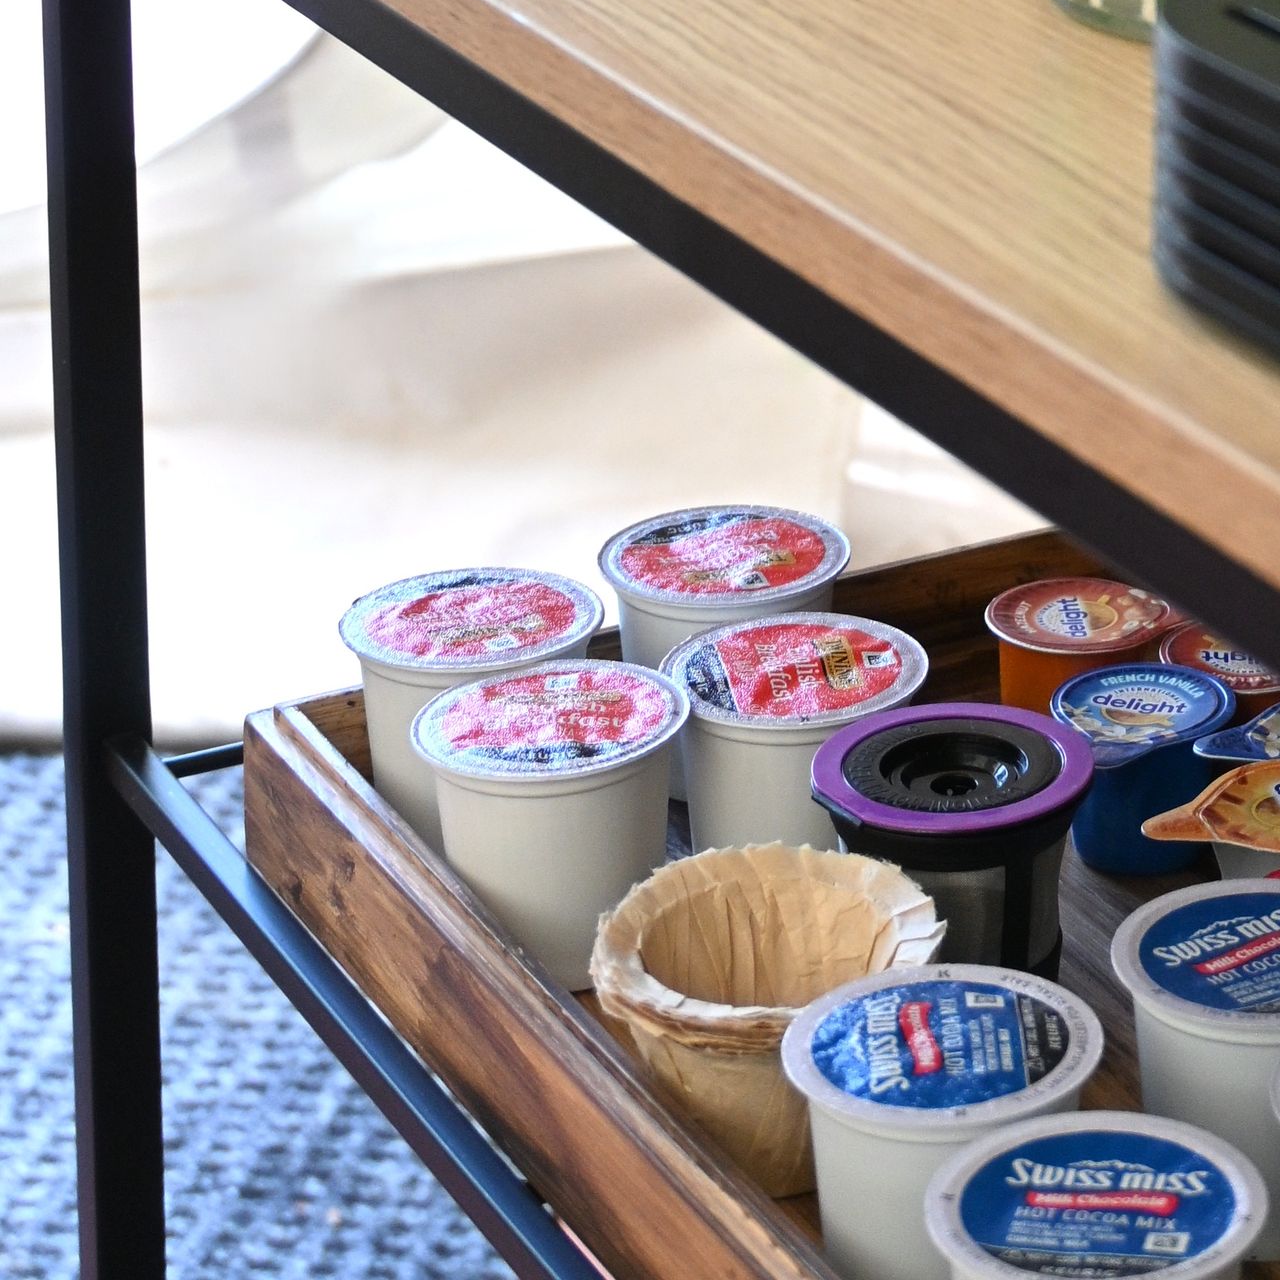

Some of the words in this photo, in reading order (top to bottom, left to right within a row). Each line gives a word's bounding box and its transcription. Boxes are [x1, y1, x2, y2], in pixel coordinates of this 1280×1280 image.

[1057, 598, 1088, 637] delight
[1201, 650, 1261, 665] light
[1100, 674, 1156, 687] FRENCH
[1158, 675, 1205, 698] VANILLA
[1213, 672, 1272, 683] AZELNU
[1092, 694, 1187, 714] delight
[1113, 687, 1181, 703] INTERNATIONAL
[1205, 952, 1237, 972] Milk
[1207, 969, 1242, 986] HOT
[938, 997, 958, 1015] MIX
[944, 1050, 966, 1075] HOT
[1014, 1206, 1057, 1219] HOT
[1061, 1208, 1130, 1226] COCOA
[1135, 1216, 1178, 1231] MIX
